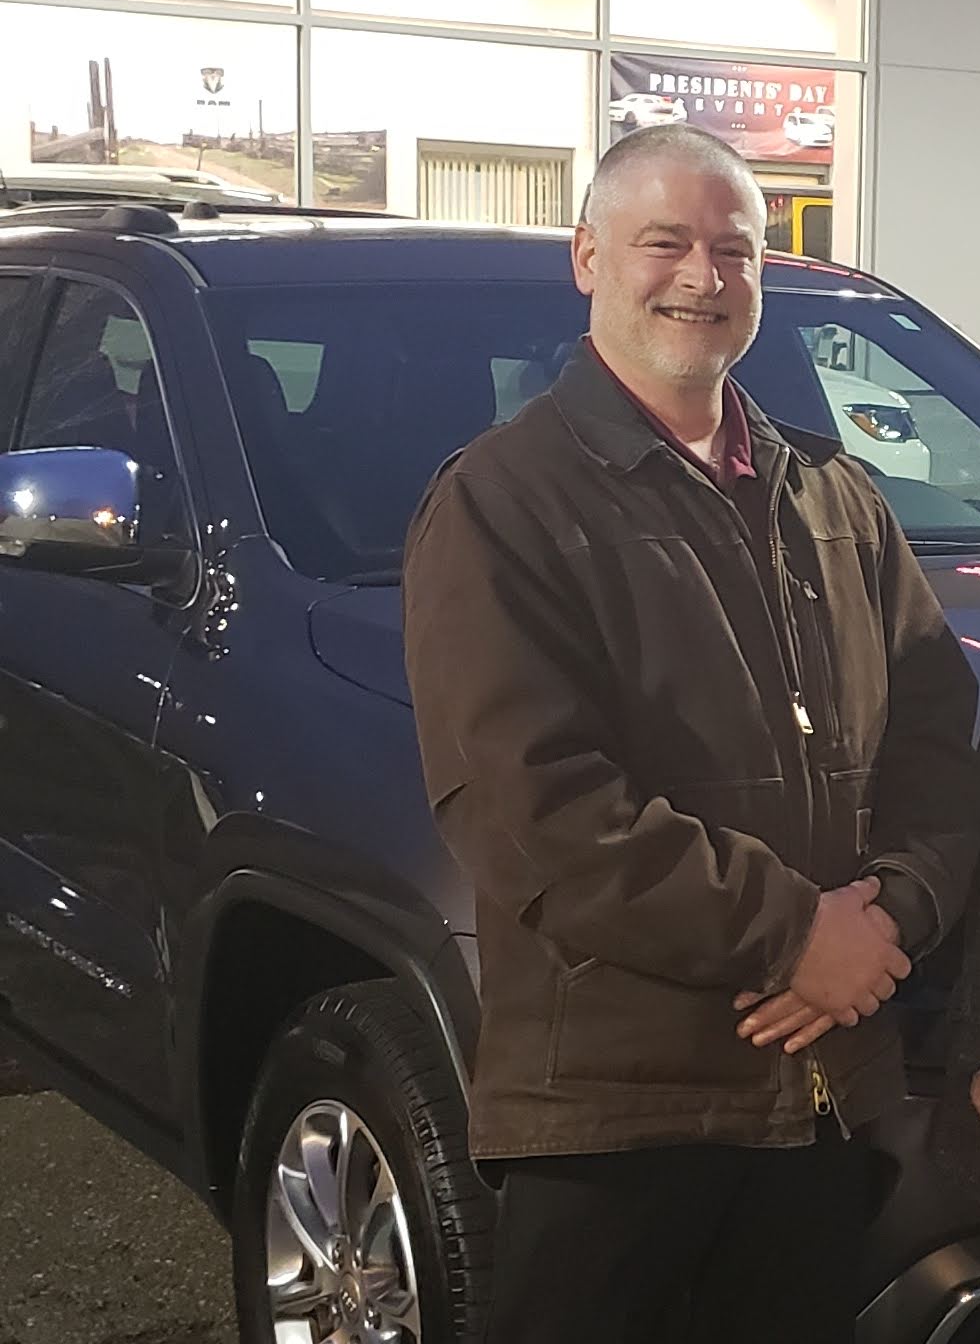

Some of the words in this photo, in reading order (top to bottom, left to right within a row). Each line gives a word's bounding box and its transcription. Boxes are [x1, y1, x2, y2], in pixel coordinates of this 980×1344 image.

[649, 72, 782, 101] PRESIDENTS'
[788, 82, 828, 104] DAY
[694, 97, 784, 117] EVENT
